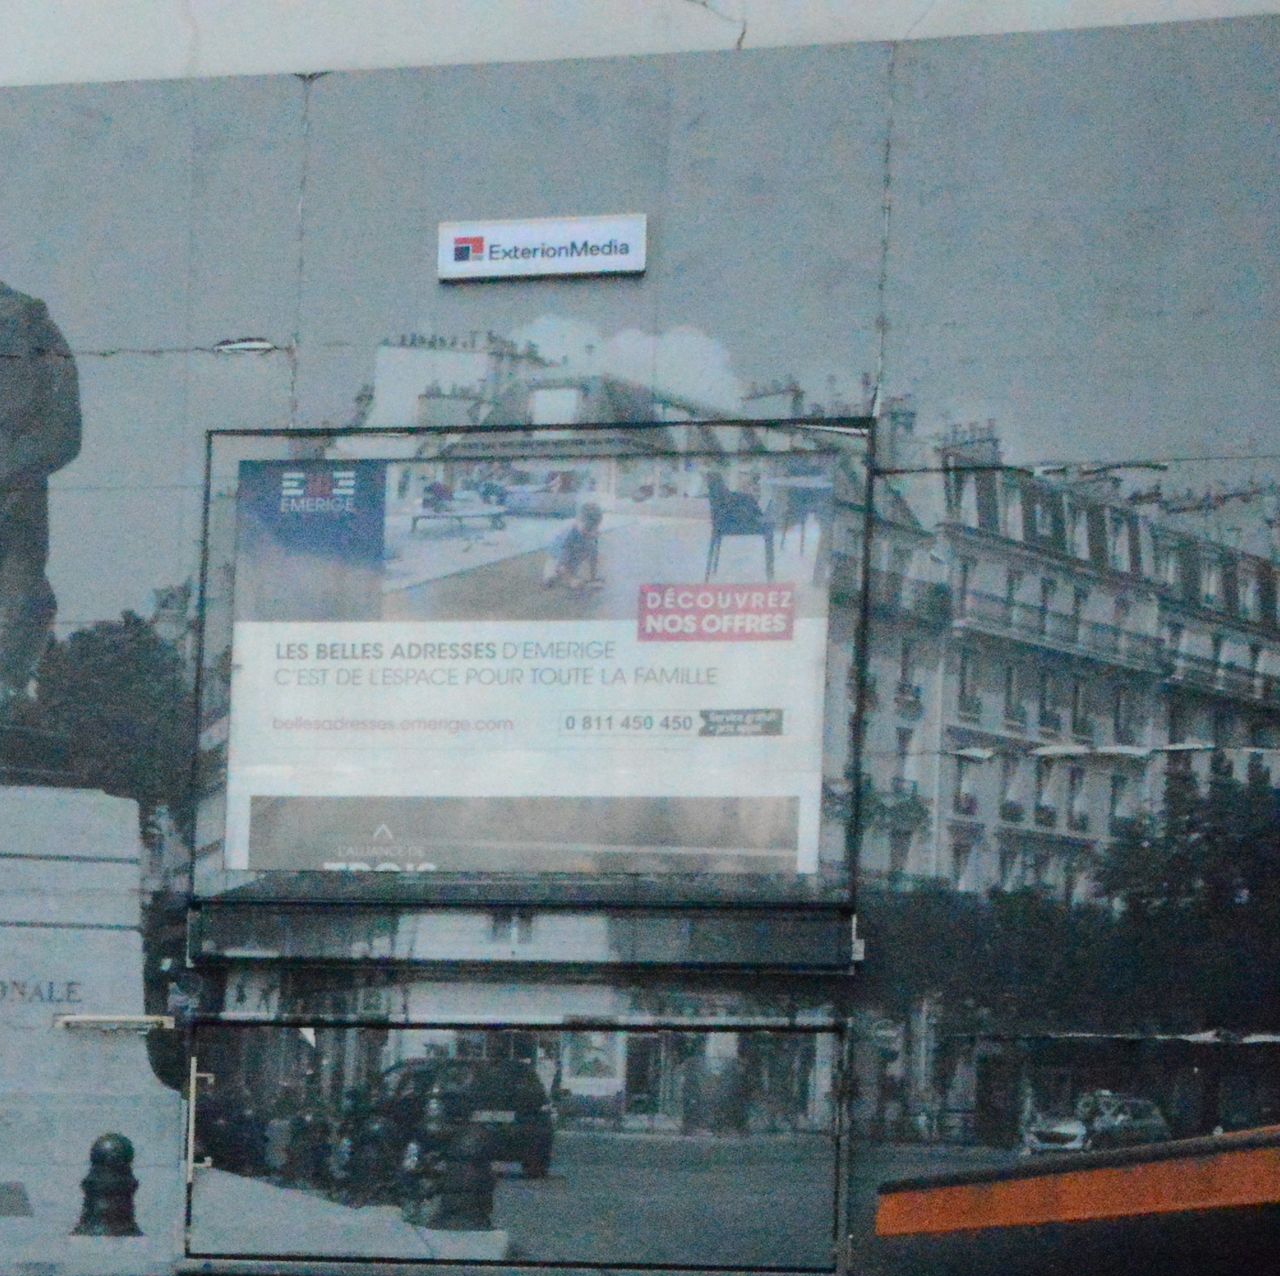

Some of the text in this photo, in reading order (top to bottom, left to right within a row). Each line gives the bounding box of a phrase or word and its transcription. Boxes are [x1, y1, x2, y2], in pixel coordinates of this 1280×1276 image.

[489, 239, 630, 261] ExterionMedia
[281, 497, 357, 513] EMERIGE
[646, 588, 792, 609] DÉCOUVREZ
[645, 614, 786, 633] NOS OFFRES
[276, 641, 616, 660] LES BELLES ADRESSES D'EMERIGE
[274, 667, 719, 686] C'EST DE L'ESPACE POUR TOUTE LA FAMILLE
[565, 716, 576, 730] 0
[582, 716, 613, 730] 811
[620, 716, 653, 730] 450
[659, 716, 693, 730] 450
